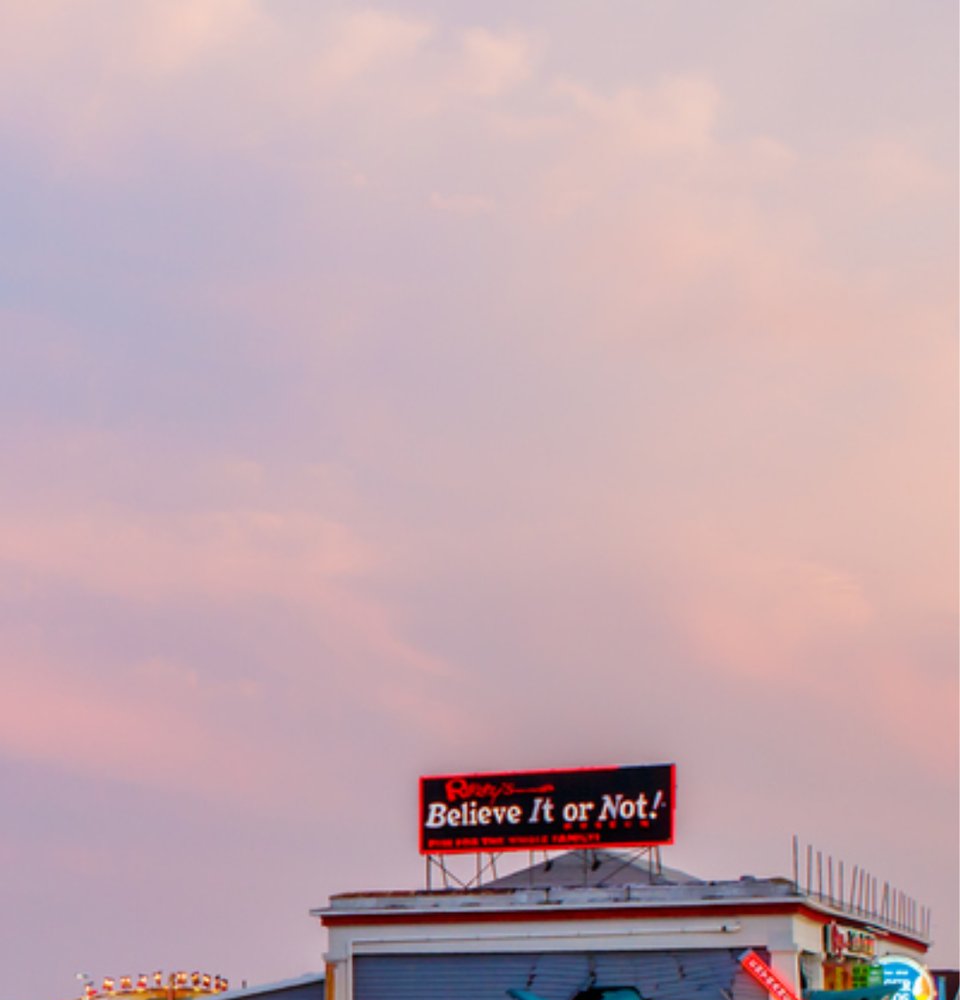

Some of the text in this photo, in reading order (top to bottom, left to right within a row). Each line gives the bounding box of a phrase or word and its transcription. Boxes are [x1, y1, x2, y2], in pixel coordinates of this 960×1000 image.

[425, 789, 664, 828] Believe It or Not!
[481, 836, 505, 846] THE
[507, 835, 549, 845] WHOLE
